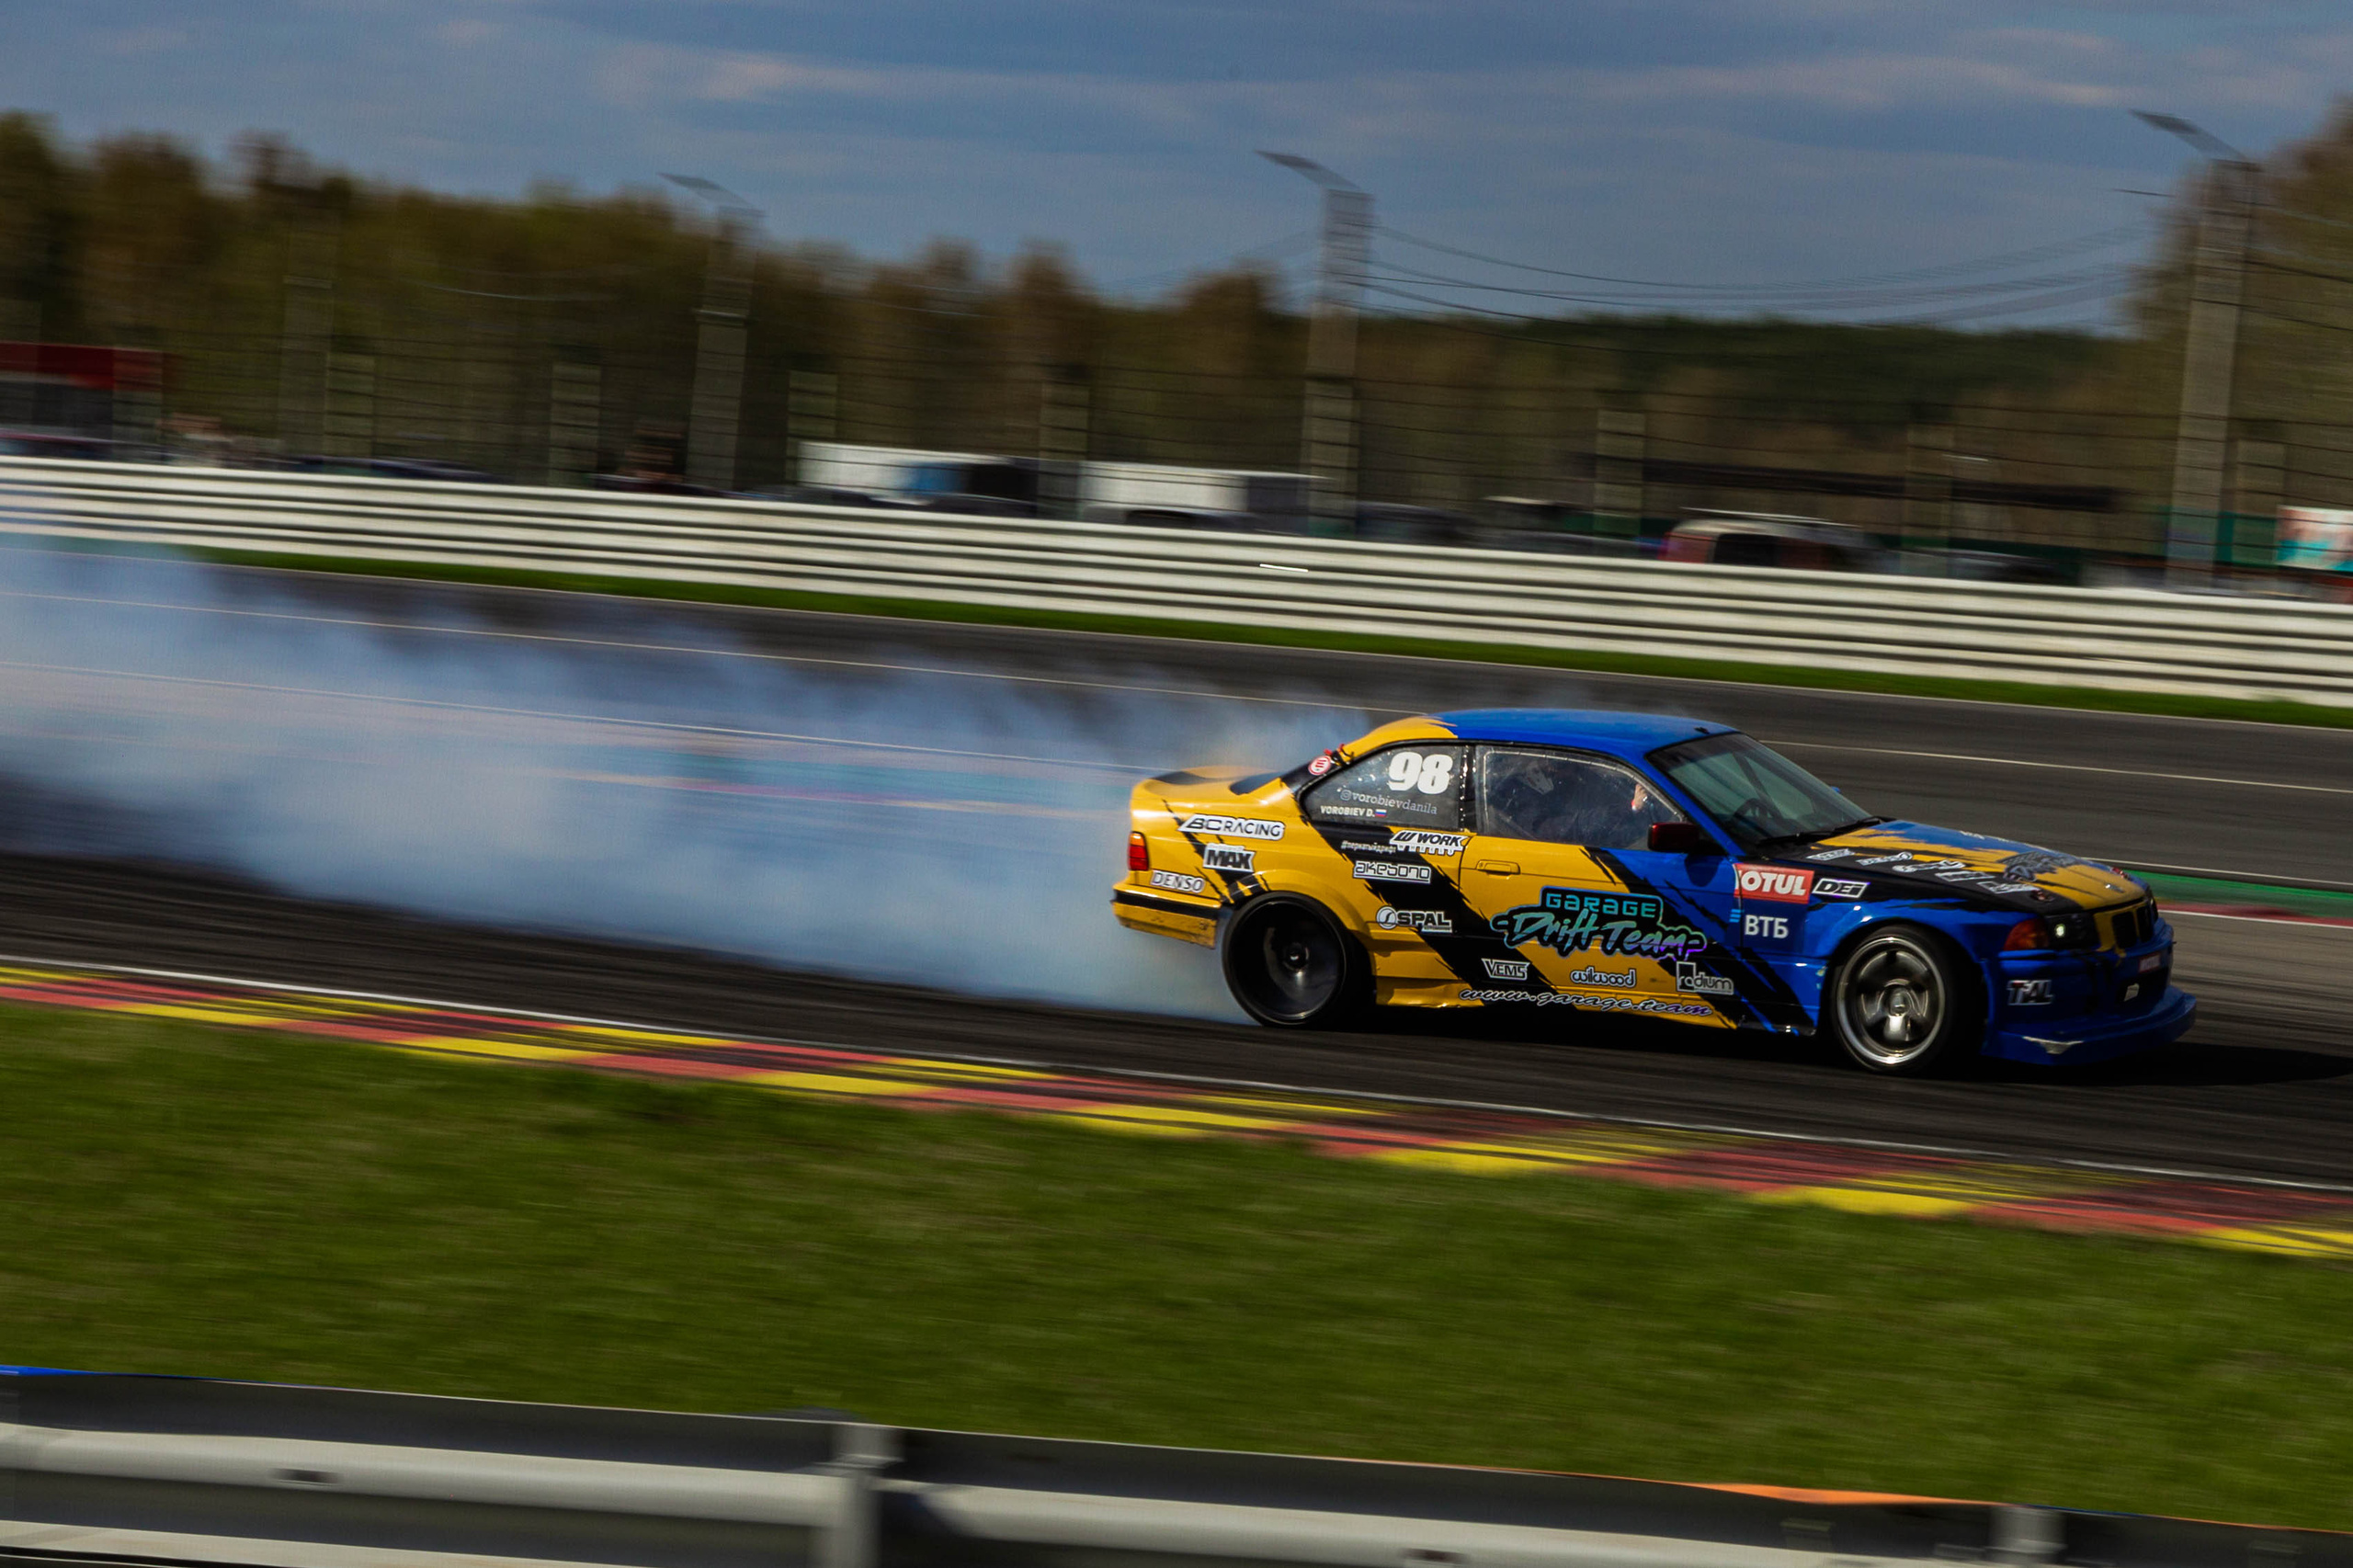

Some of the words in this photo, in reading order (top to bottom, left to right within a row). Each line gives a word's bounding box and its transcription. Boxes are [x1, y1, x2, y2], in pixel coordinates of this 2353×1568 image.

[1387, 751, 1454, 795] 98
[1320, 805, 1366, 817] VOROBIEV
[1366, 807, 1376, 818] D.
[1223, 820, 1281, 837] RACING
[1417, 833, 1462, 847] WORK
[1206, 849, 1252, 870] MAX
[1153, 871, 1204, 892] DENSO
[1396, 911, 1451, 926] SPAL
[1745, 914, 1790, 939] ВТБ
[1512, 908, 1599, 952] Drift
[1600, 920, 1689, 956] Team
[1571, 967, 1636, 987] wilwood
[1678, 972, 1733, 990] radium
[1460, 987, 1712, 1016] www.garage.team
